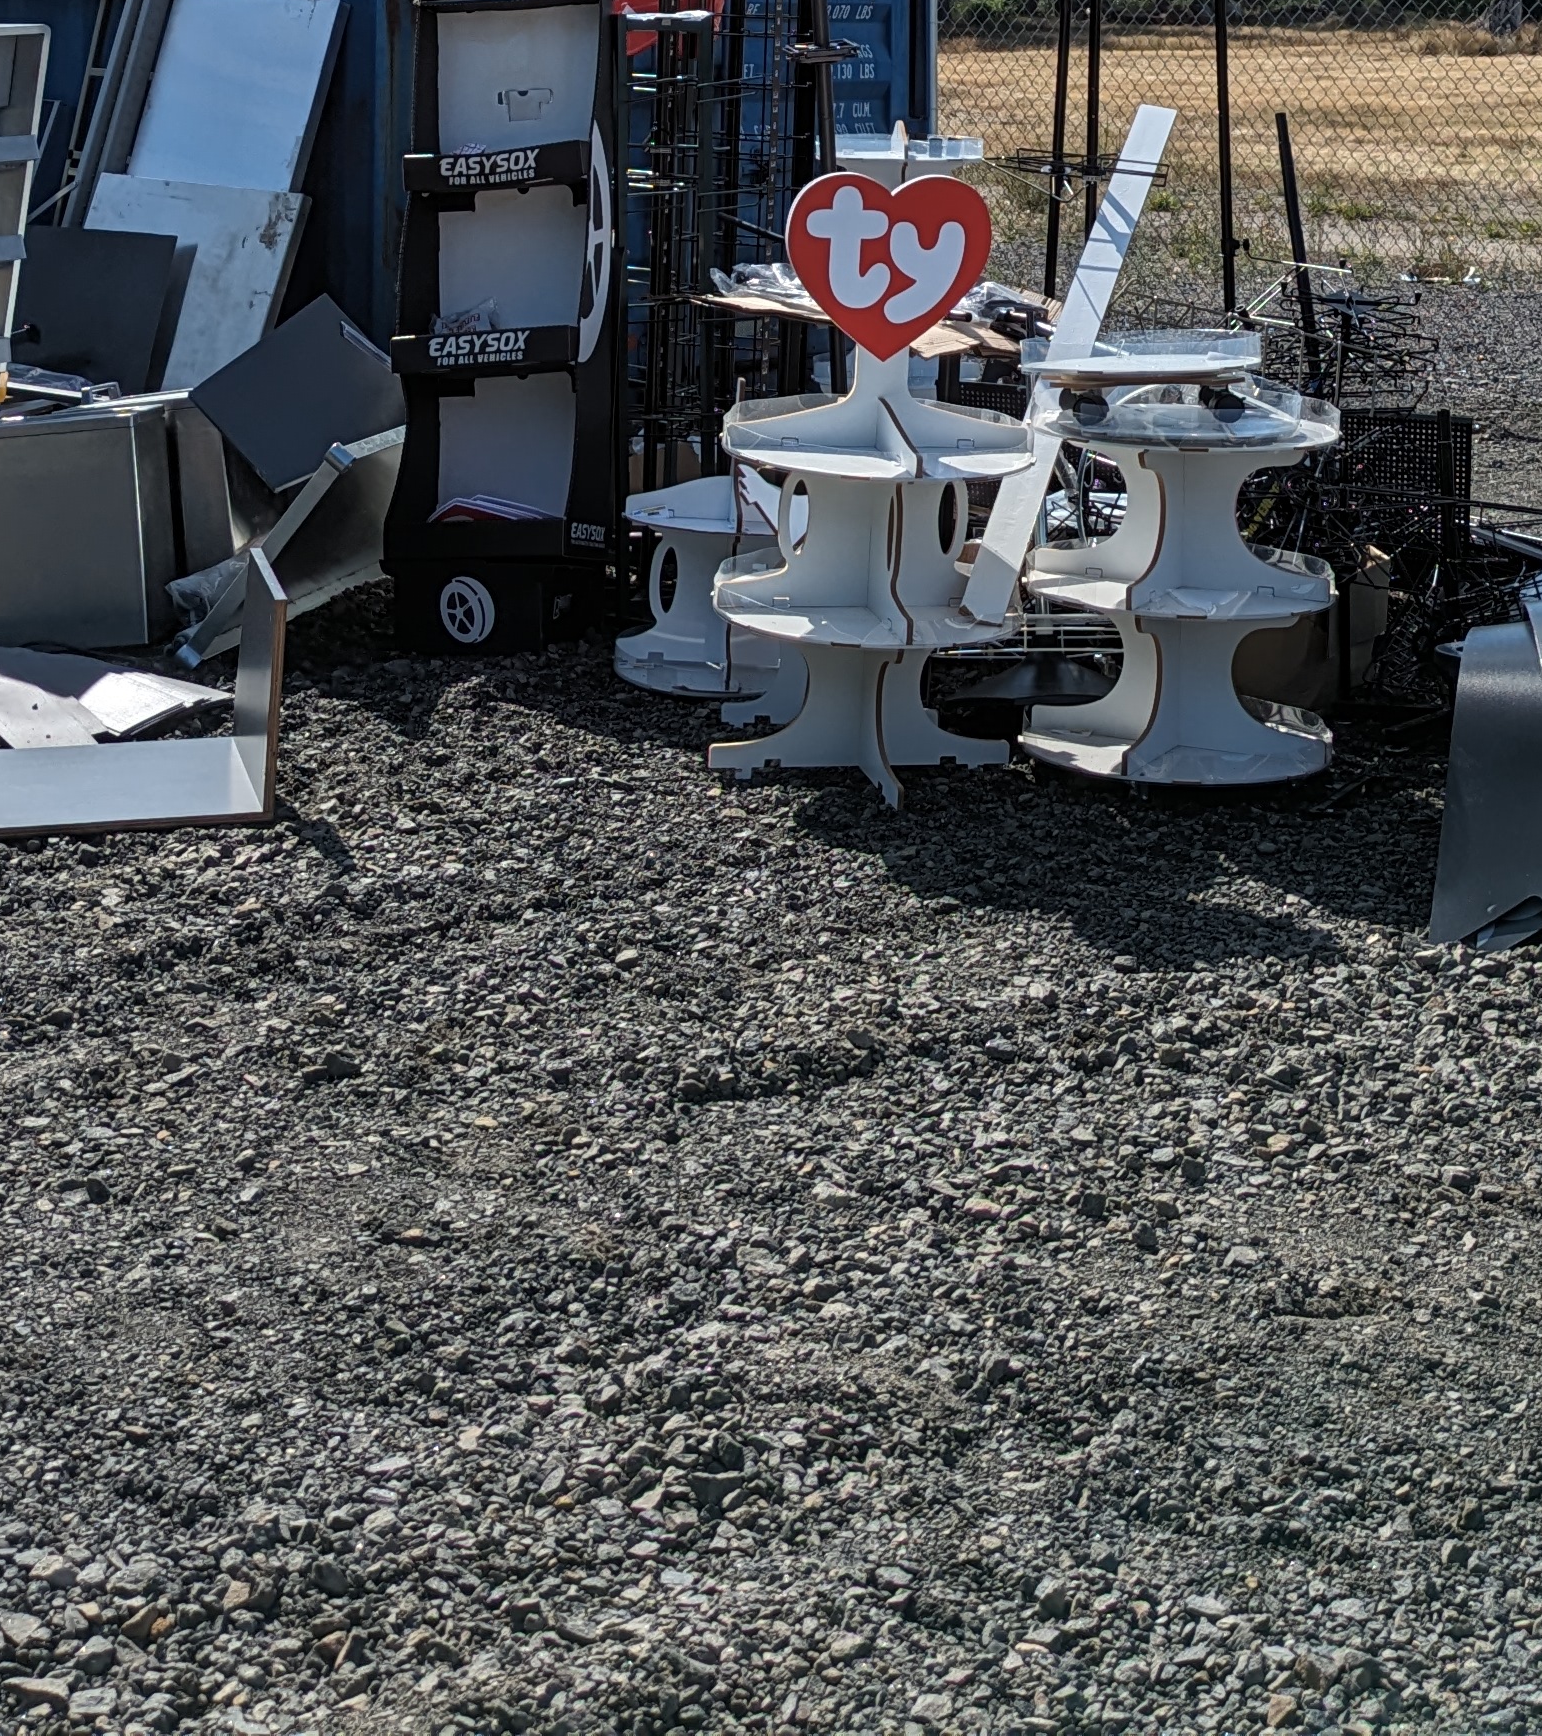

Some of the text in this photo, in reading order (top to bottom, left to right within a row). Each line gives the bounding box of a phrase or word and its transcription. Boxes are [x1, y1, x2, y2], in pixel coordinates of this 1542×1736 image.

[855, 4, 874, 20] LBS
[859, 62, 875, 79] LBS
[440, 148, 541, 176] EASYSOX
[449, 168, 535, 186] FOR ALL VEHICLES
[806, 185, 966, 324] ty
[428, 330, 531, 357] EASYSOX
[436, 350, 524, 367] FOR ALL VEHICLES
[570, 522, 606, 542] EASYSOX
